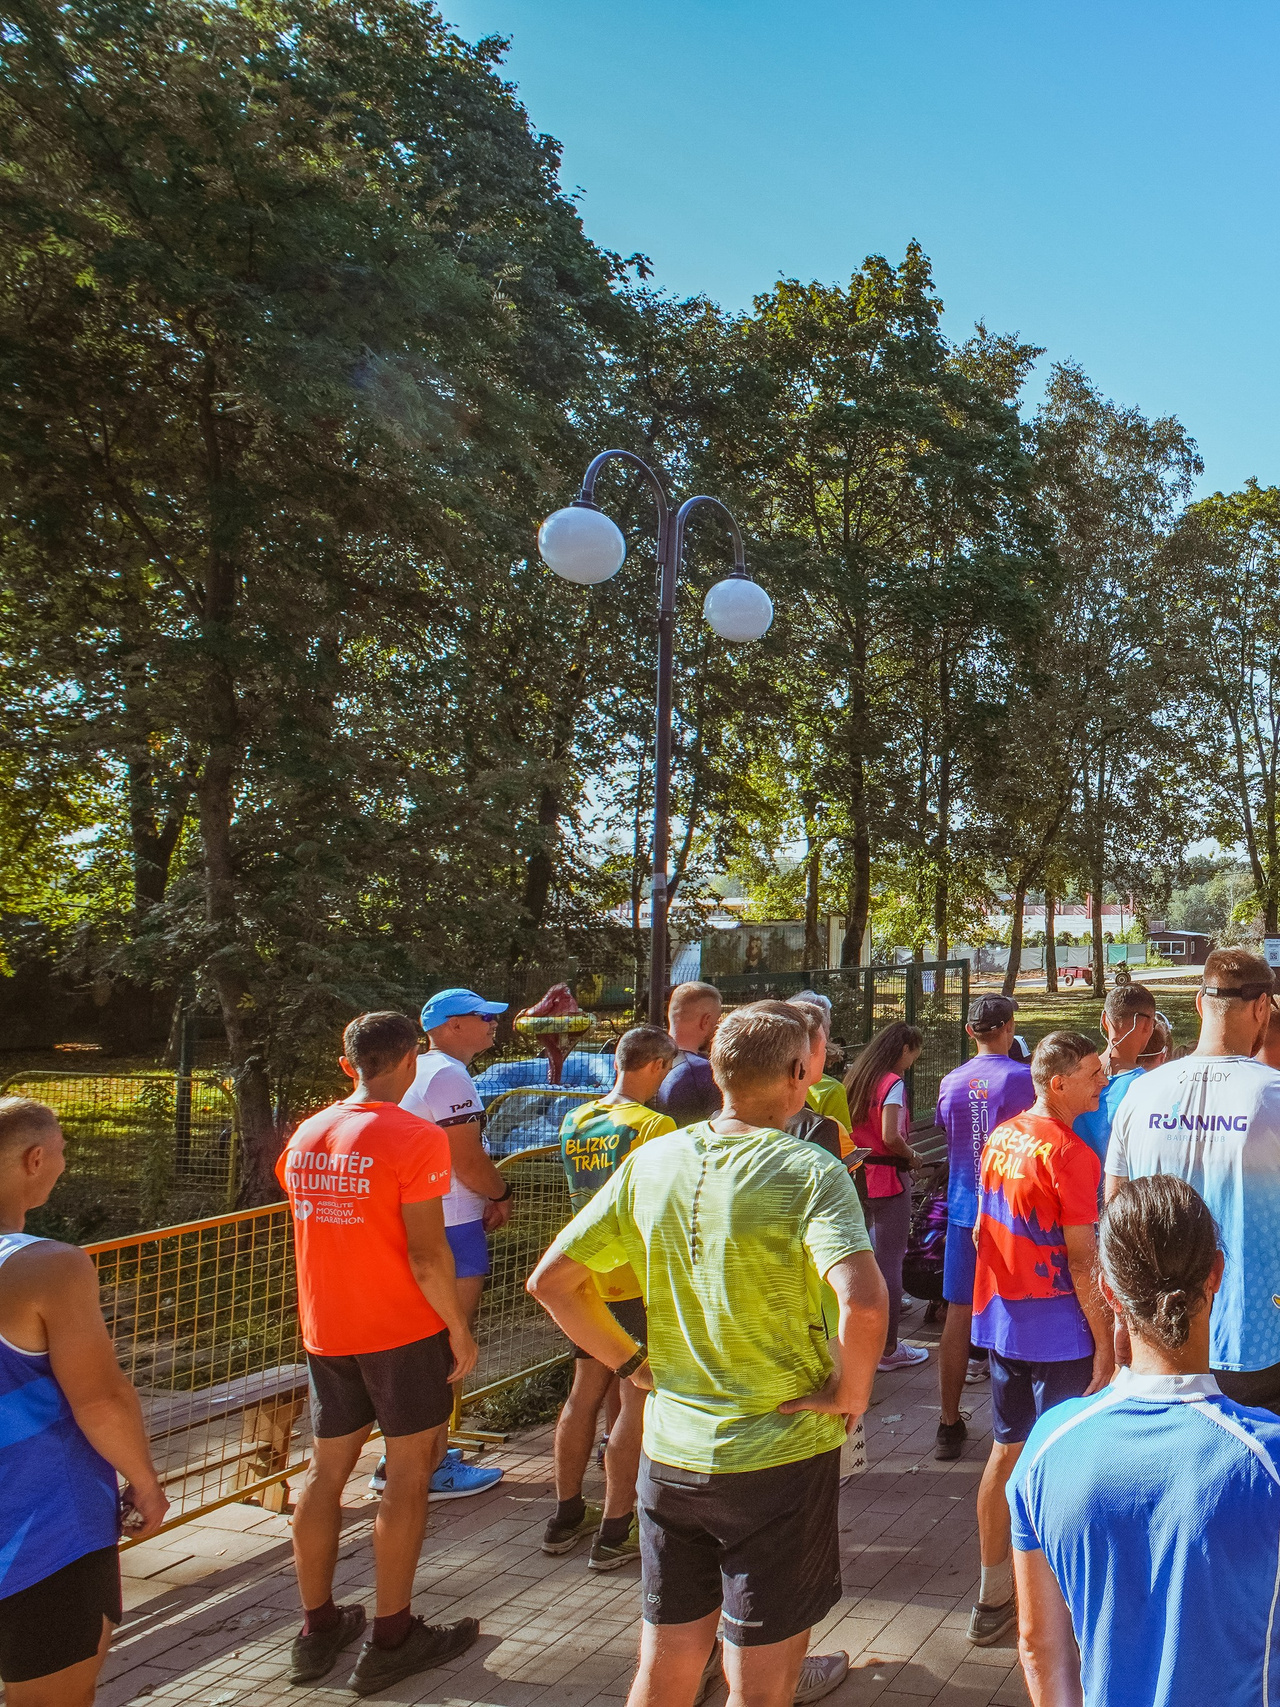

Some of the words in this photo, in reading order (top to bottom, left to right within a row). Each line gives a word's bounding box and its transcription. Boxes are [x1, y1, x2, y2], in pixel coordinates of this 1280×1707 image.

[1149, 1113, 1248, 1131] RUNNING
[565, 1134, 620, 1155] BLIZKO
[572, 1153, 614, 1172] TRAIL
[986, 1149, 1026, 1179] TRAIL
[316, 1208, 354, 1217] MOSCOW
[316, 1216, 365, 1226] MARATHON
